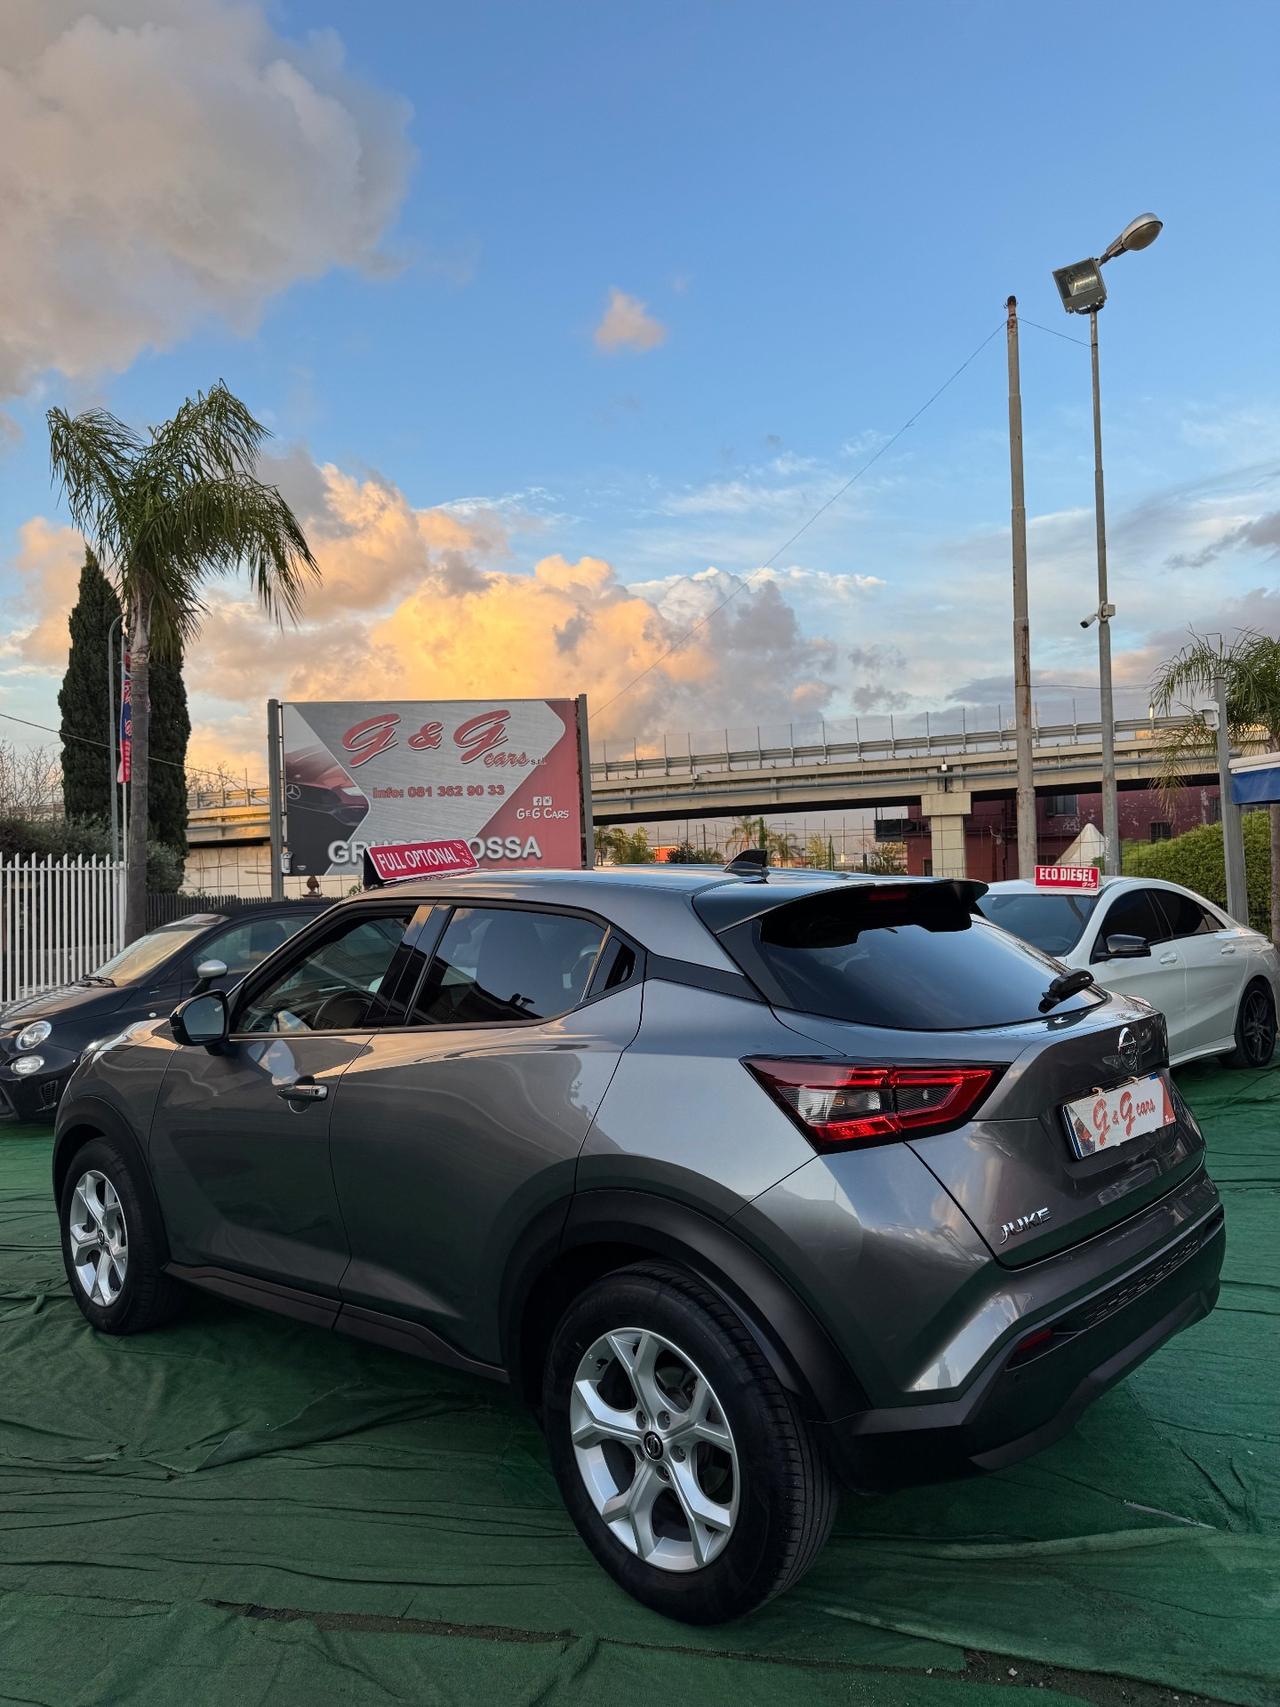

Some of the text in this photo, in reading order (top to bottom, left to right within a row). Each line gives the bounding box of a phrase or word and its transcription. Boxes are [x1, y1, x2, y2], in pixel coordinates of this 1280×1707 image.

[342, 713, 400, 768] G
[408, 721, 444, 750] &
[453, 709, 511, 764] G
[483, 751, 530, 768] cars
[372, 787, 404, 798] Info:
[407, 786, 433, 798] 081
[466, 785, 484, 796] 90
[487, 784, 505, 796] 33
[376, 851, 407, 872] FULL
[408, 846, 460, 869] OPTIONAL
[467, 836, 542, 859] OSSA
[1039, 867, 1094, 882] ECO DIESEL
[999, 1207, 1052, 1245] JUKE
